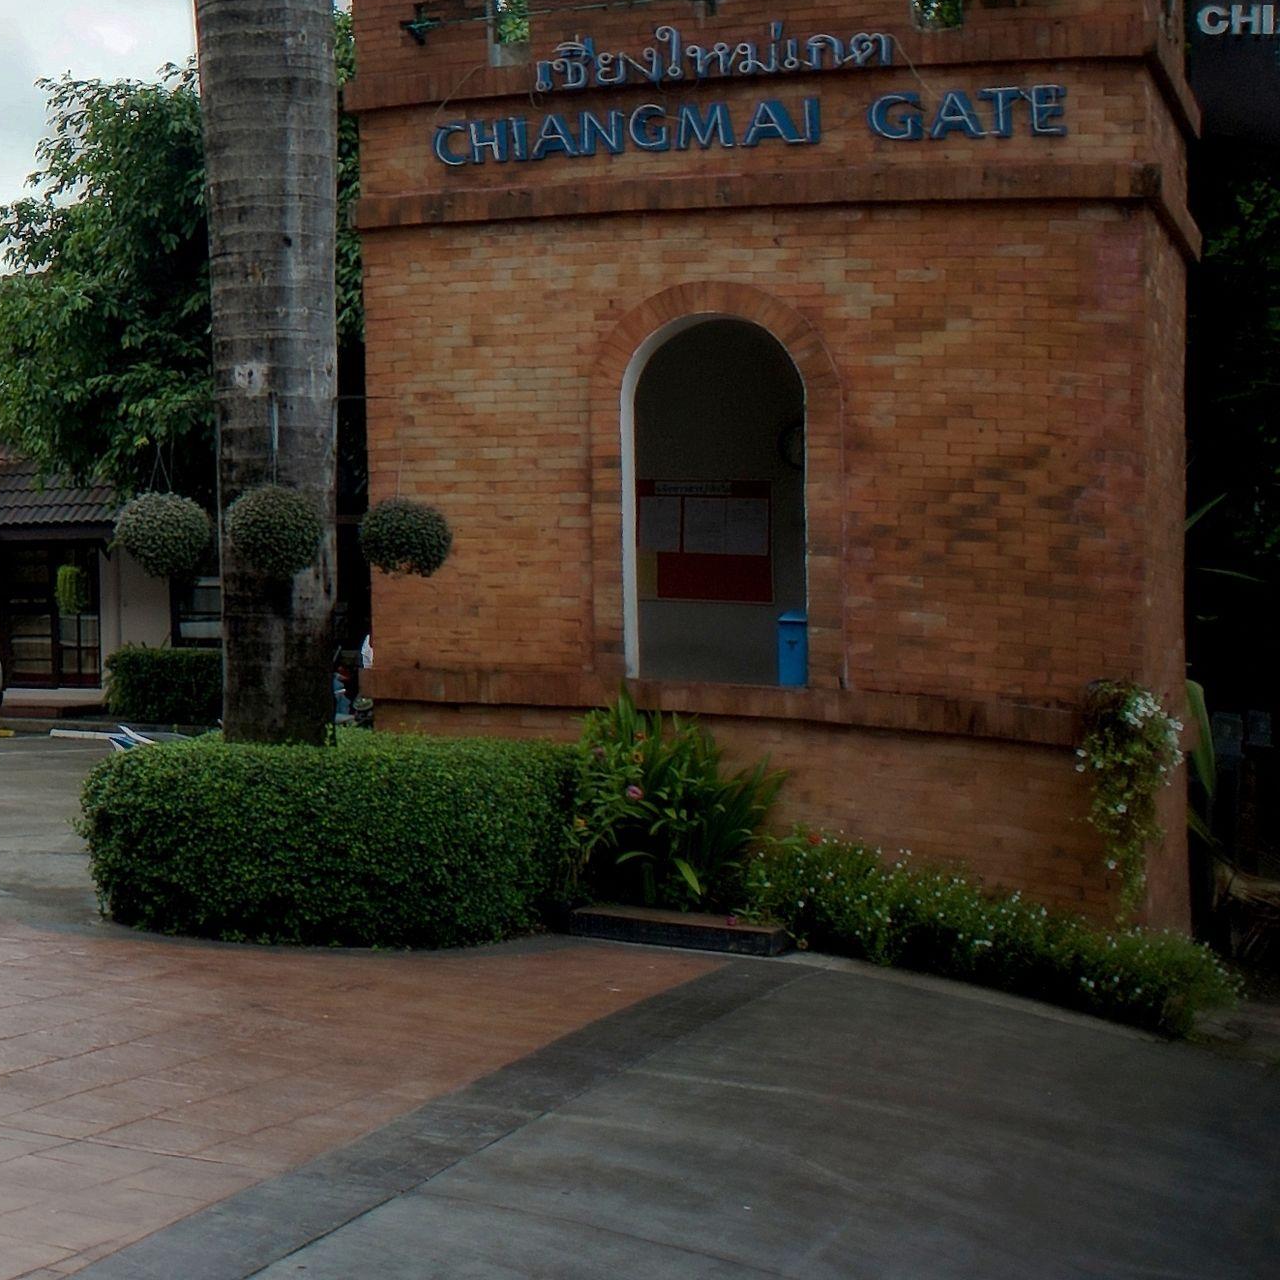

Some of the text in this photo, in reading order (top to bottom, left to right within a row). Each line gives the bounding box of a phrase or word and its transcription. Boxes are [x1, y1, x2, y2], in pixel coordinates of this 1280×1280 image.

[1198, 4, 1280, 35] CHI
[534, 21, 891, 91] เชียงใหม่เกต
[867, 83, 1068, 140] GATE
